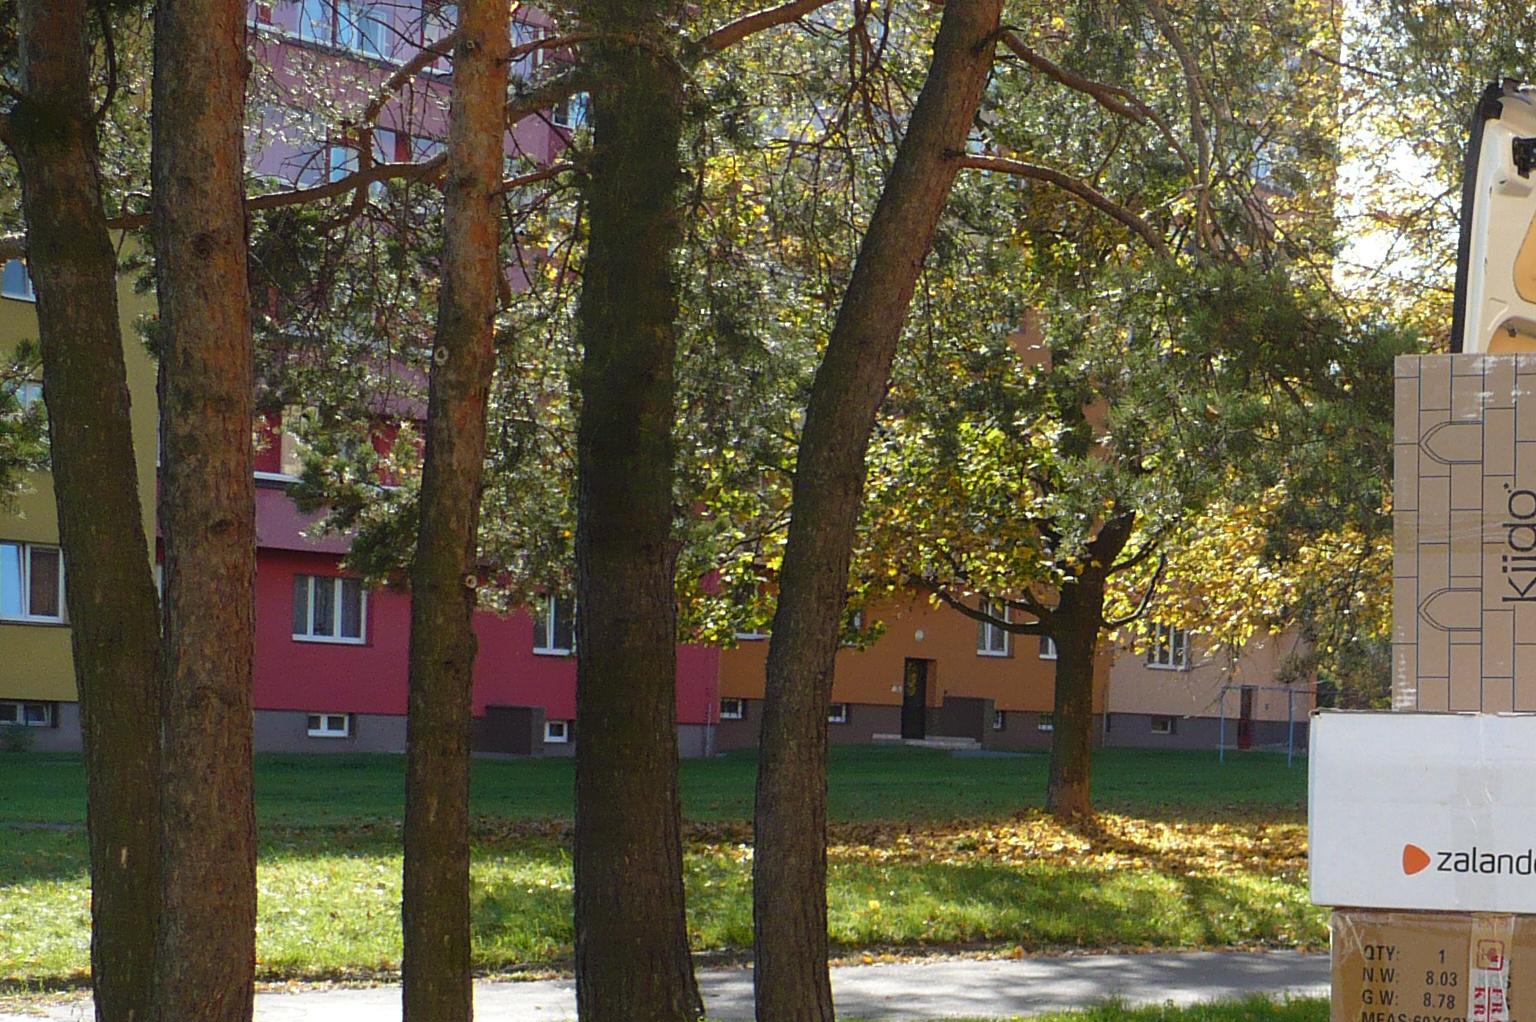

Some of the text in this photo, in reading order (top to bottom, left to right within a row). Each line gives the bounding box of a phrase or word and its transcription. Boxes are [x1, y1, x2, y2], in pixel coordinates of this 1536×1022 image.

[1364, 945, 1446, 963] QTY: 1
[1425, 971, 1457, 987] 8.03
[1423, 992, 1455, 1009] 8.78
